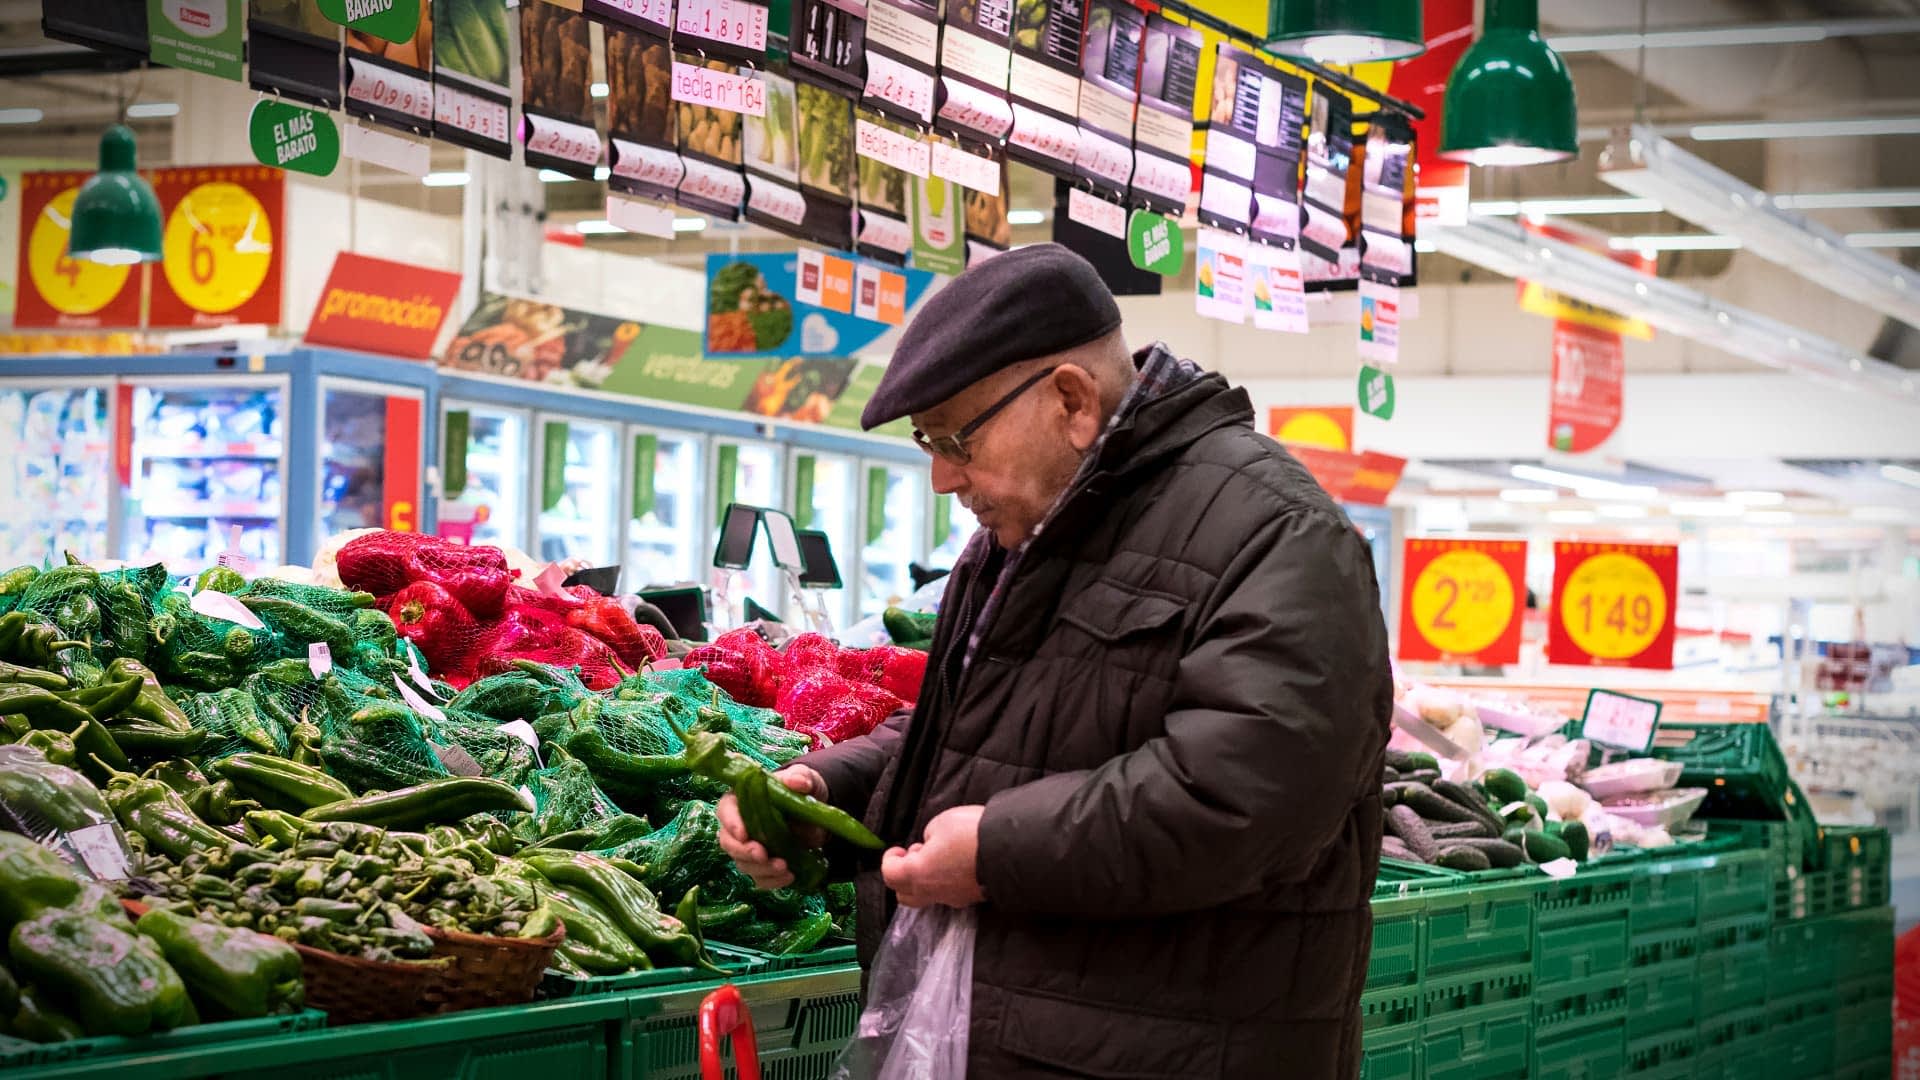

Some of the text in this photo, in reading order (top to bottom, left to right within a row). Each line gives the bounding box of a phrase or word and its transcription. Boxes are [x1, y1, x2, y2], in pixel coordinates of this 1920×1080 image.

[345, 0, 393, 23] BARATO
[703, 8, 745, 41] 1,89
[372, 79, 414, 110] 0,99
[677, 71, 713, 101] tecla
[738, 82, 763, 111] 164
[273, 111, 314, 145] EL MÁS
[276, 132, 317, 165] BARATO
[189, 222, 215, 286] 6
[319, 287, 442, 331] promoción
